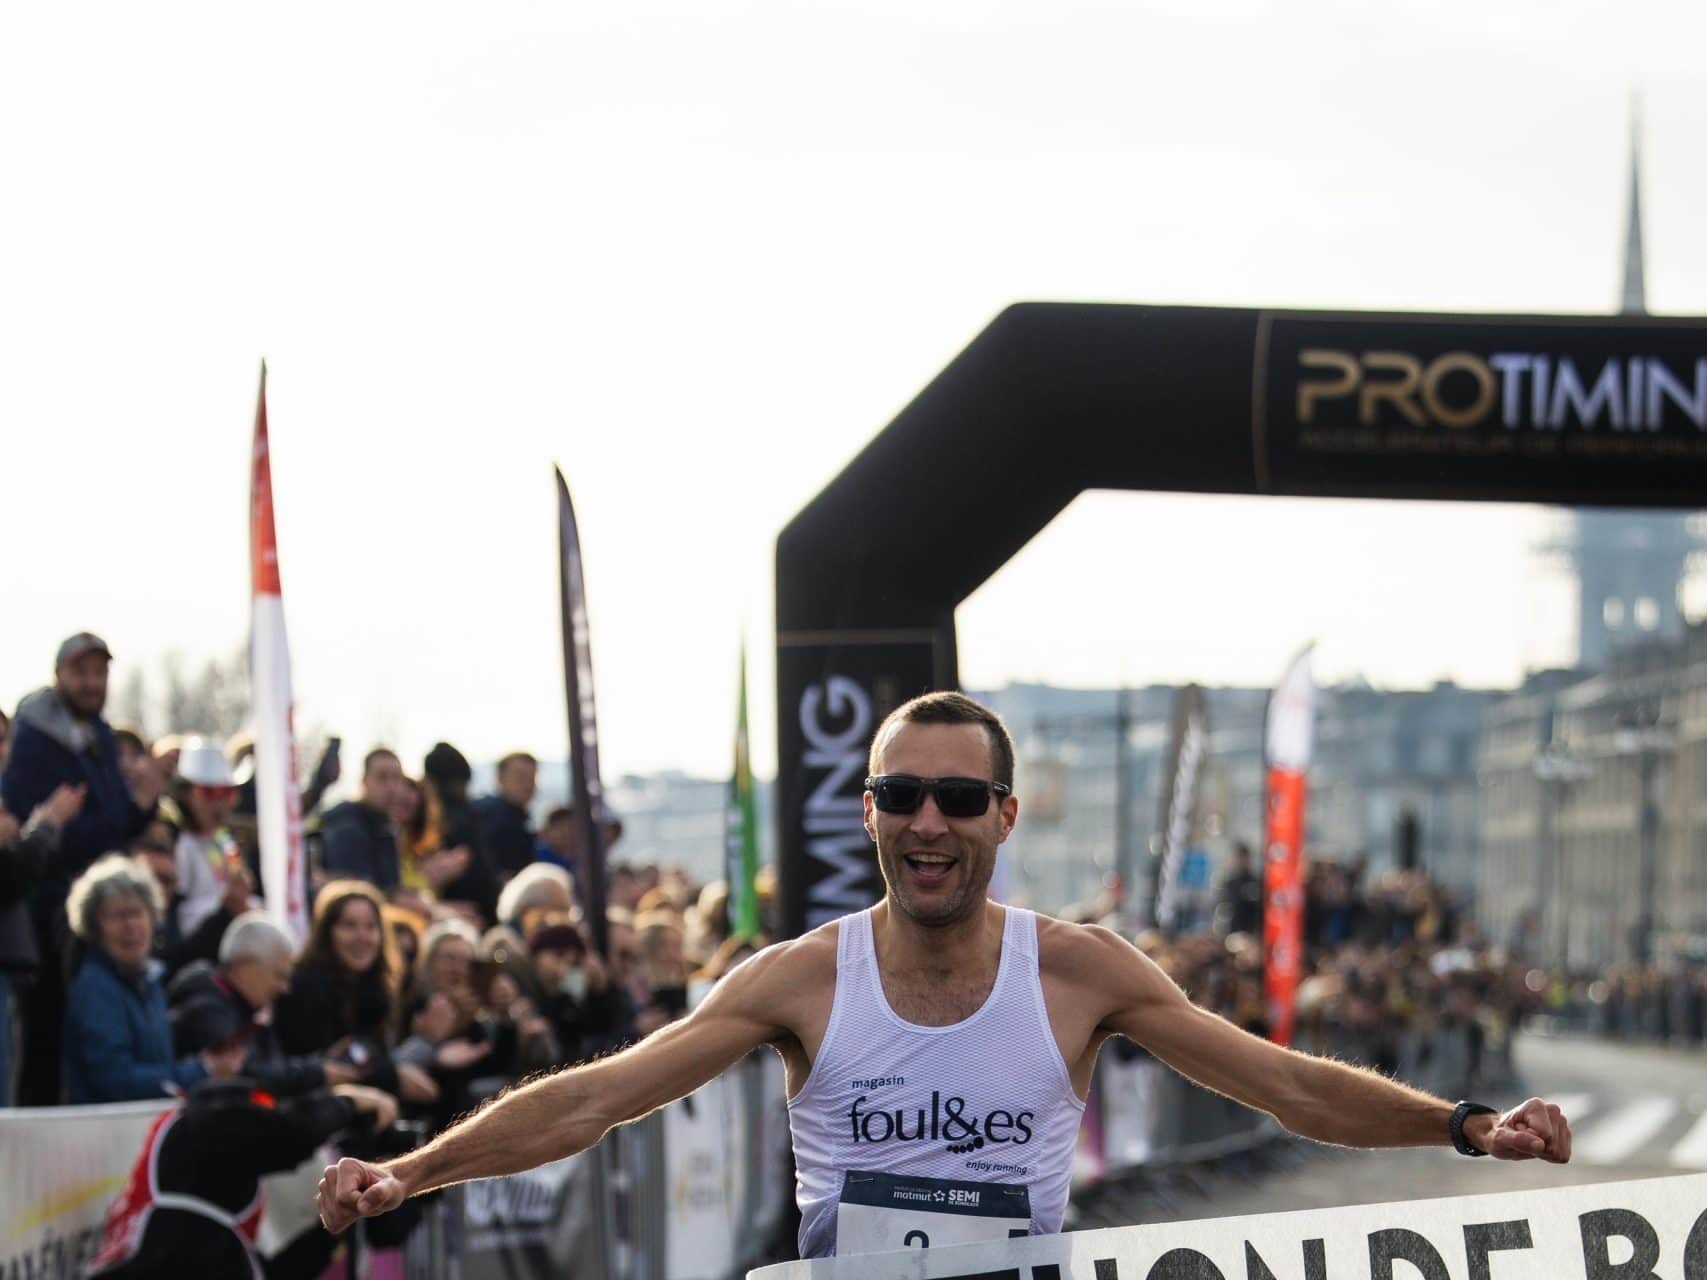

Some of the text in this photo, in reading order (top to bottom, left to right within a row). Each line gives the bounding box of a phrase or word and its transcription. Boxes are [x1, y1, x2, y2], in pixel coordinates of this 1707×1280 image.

[851, 1075, 905, 1090] magasin
[848, 1090, 1034, 1145] foul&es
[965, 1160, 1028, 1176] enjoy running
[893, 1189, 980, 1203] matmut SEMI
